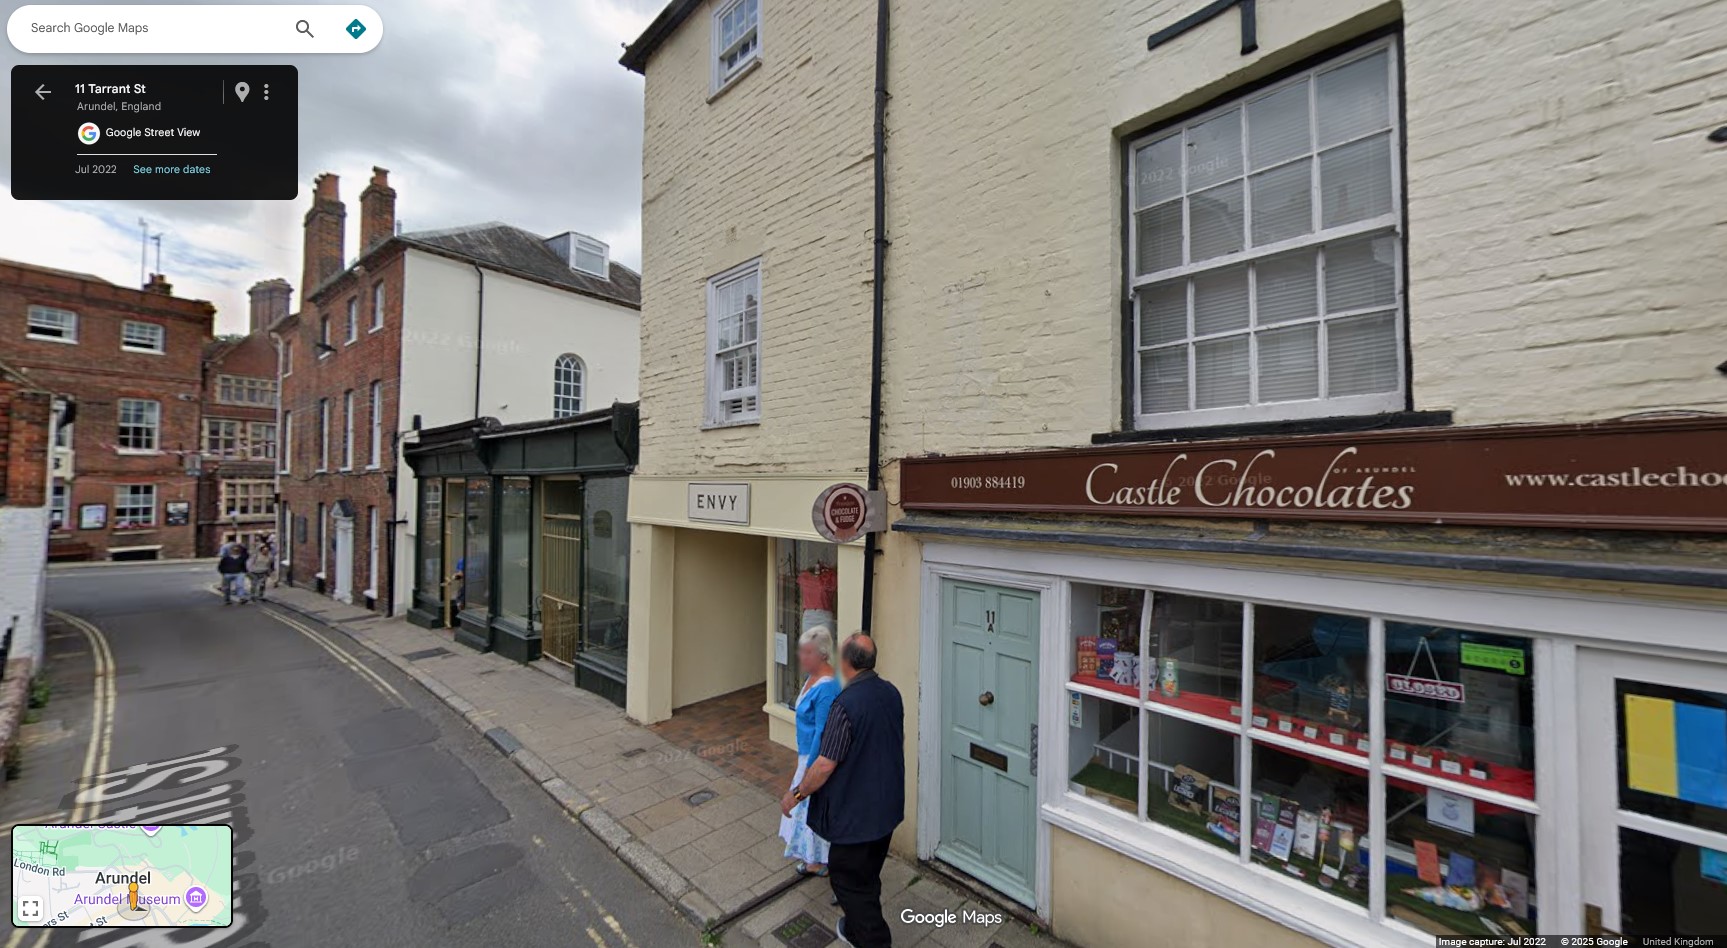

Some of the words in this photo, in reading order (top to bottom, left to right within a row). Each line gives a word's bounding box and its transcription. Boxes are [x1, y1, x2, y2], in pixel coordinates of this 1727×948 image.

[951, 476, 982, 489] 01903
[985, 475, 1026, 489] 884419
[1086, 454, 1187, 505] Castle
[1194, 446, 1414, 509] Chocolates
[697, 494, 738, 511] ENVY
[831, 506, 859, 516] CHOCOLATE
[840, 515, 856, 524] FUDGE
[985, 609, 996, 625] 11
[987, 622, 995, 634] A
